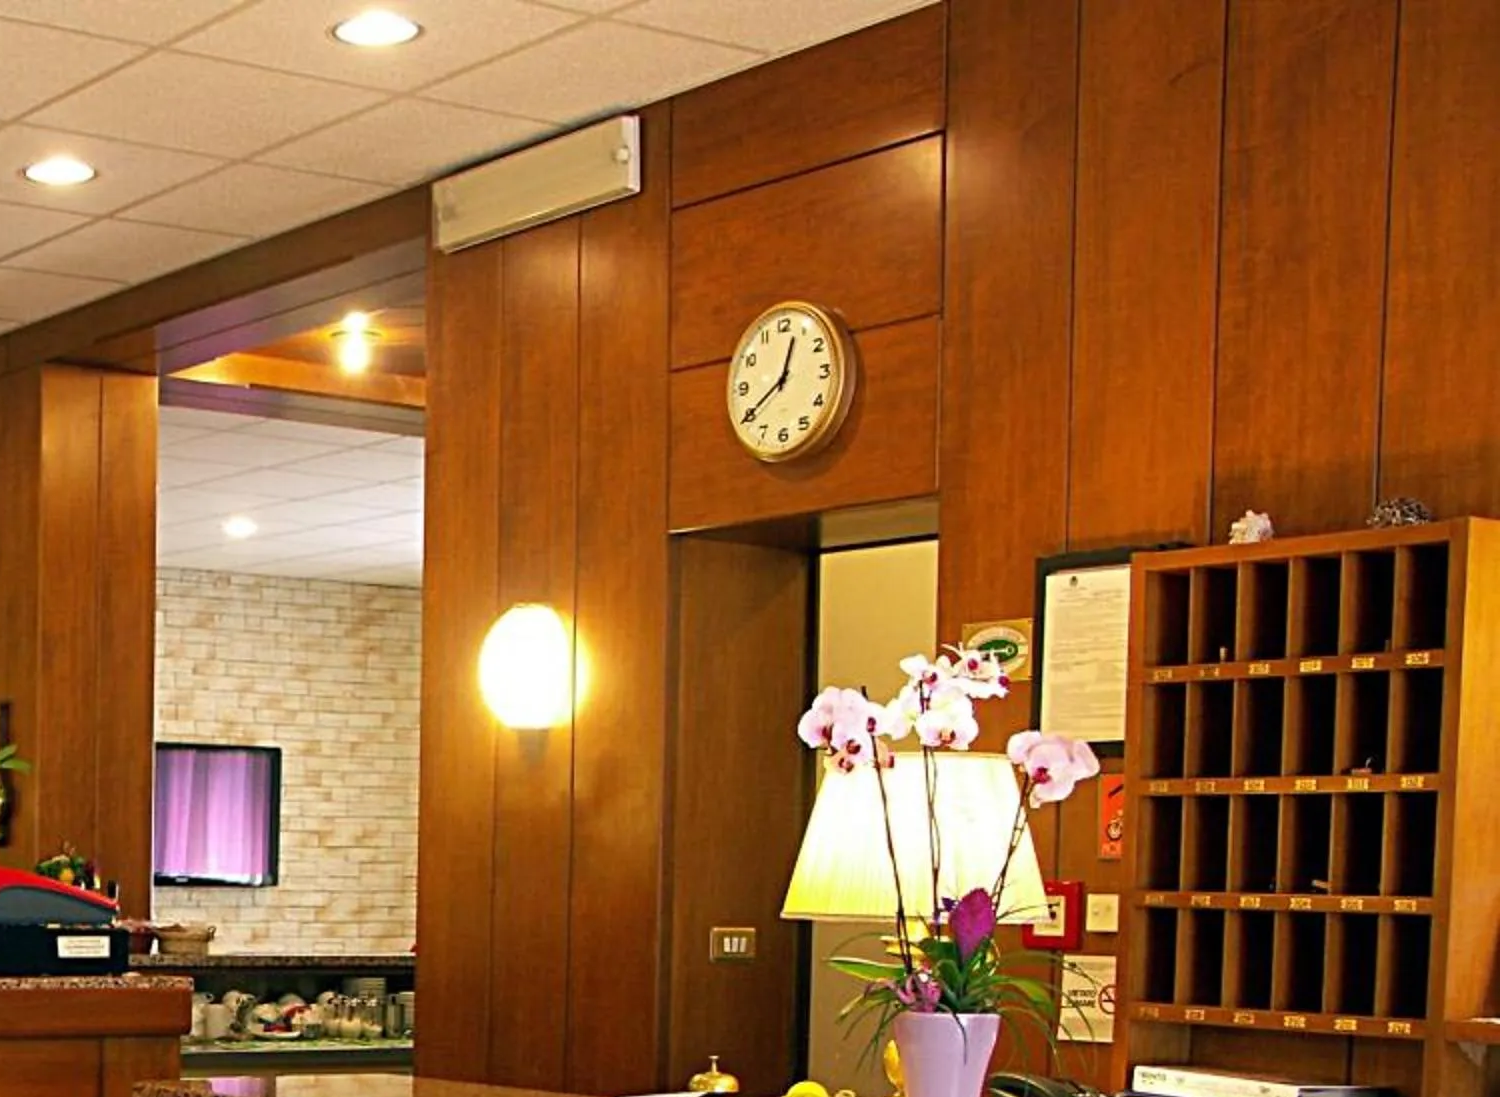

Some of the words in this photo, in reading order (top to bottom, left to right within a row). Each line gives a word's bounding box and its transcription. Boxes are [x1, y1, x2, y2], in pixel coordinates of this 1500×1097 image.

[777, 318, 791, 333] 12
[761, 330, 769, 345] 11
[813, 337, 825, 353] 2
[745, 353, 757, 368] 10
[819, 363, 831, 379] 3
[738, 381, 749, 396] 9
[813, 393, 823, 407] 4
[797, 415, 810, 430] 5
[759, 424, 769, 439] 7
[777, 427, 789, 442] 6
